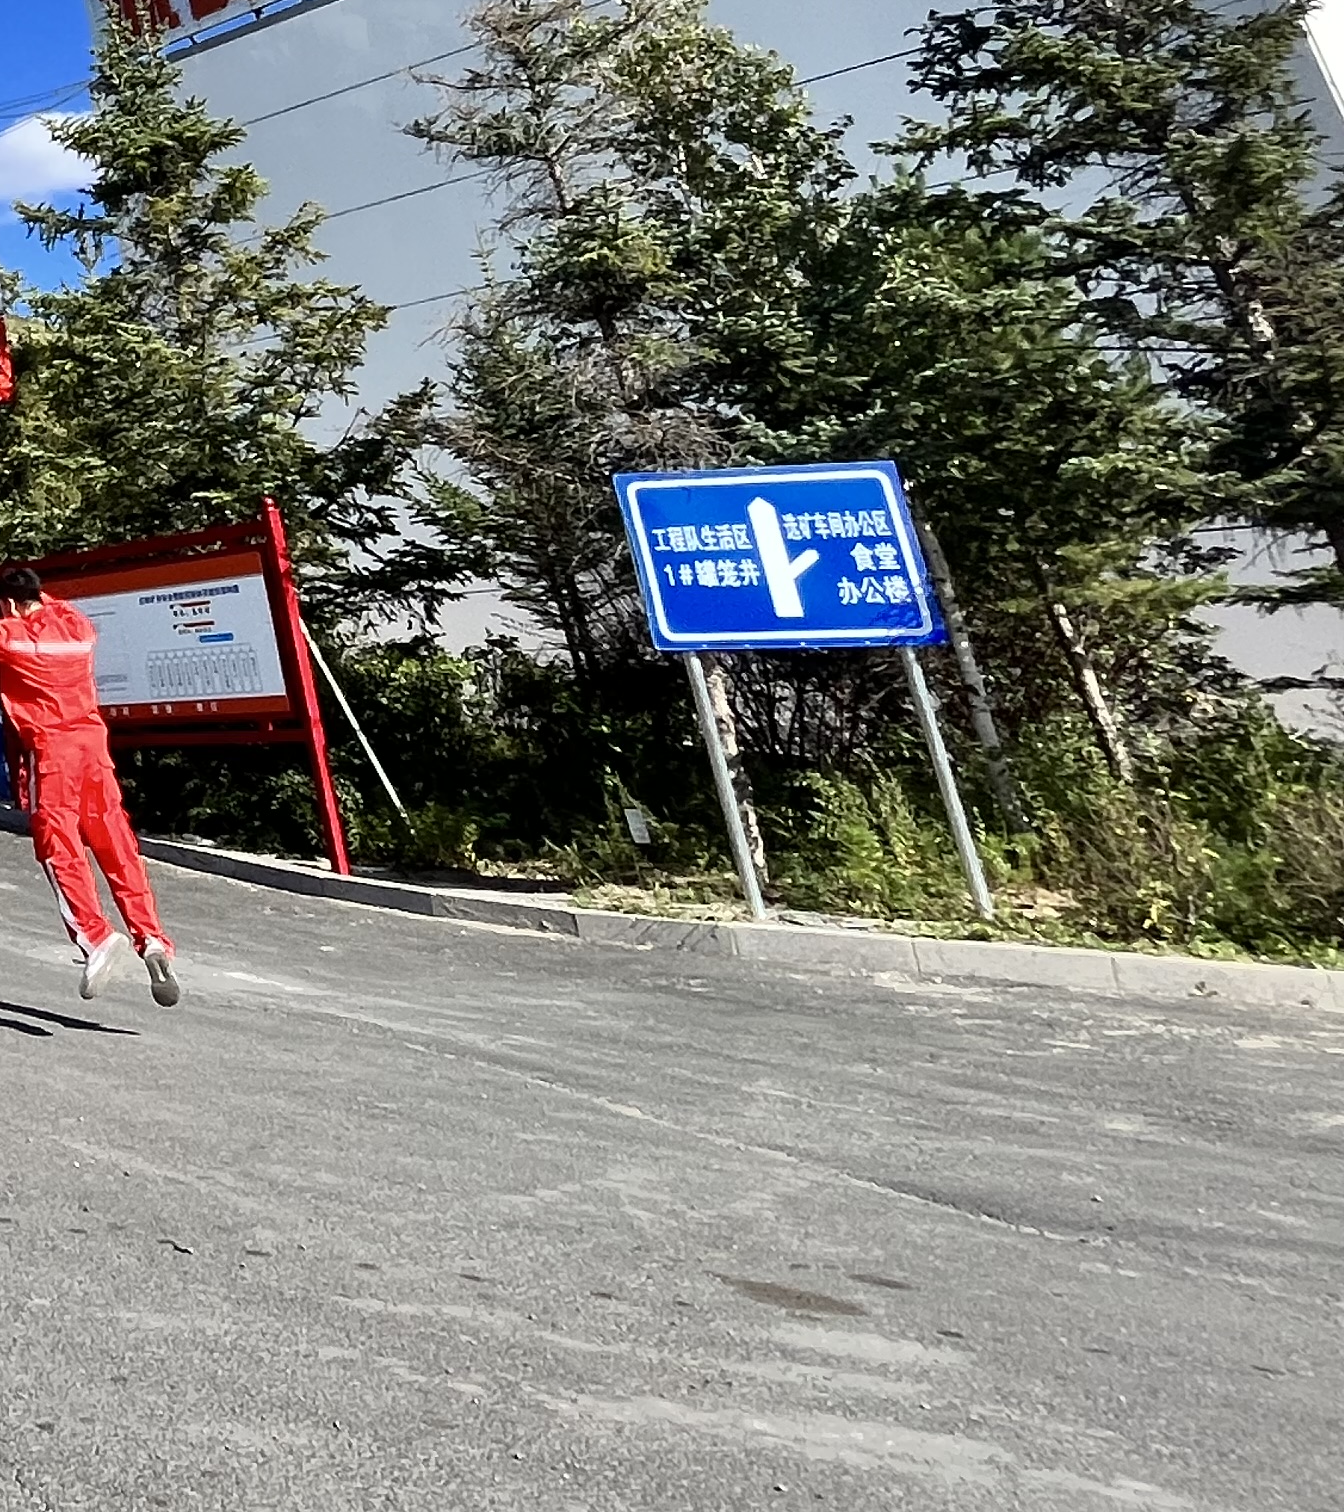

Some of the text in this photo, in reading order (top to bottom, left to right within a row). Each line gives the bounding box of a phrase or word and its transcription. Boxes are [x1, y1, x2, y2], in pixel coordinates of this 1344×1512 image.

[651, 523, 754, 552] 工程队生活区
[781, 510, 893, 540] 选矿车间办公区
[850, 541, 901, 572] 食堂
[837, 574, 912, 605] 办公楼
